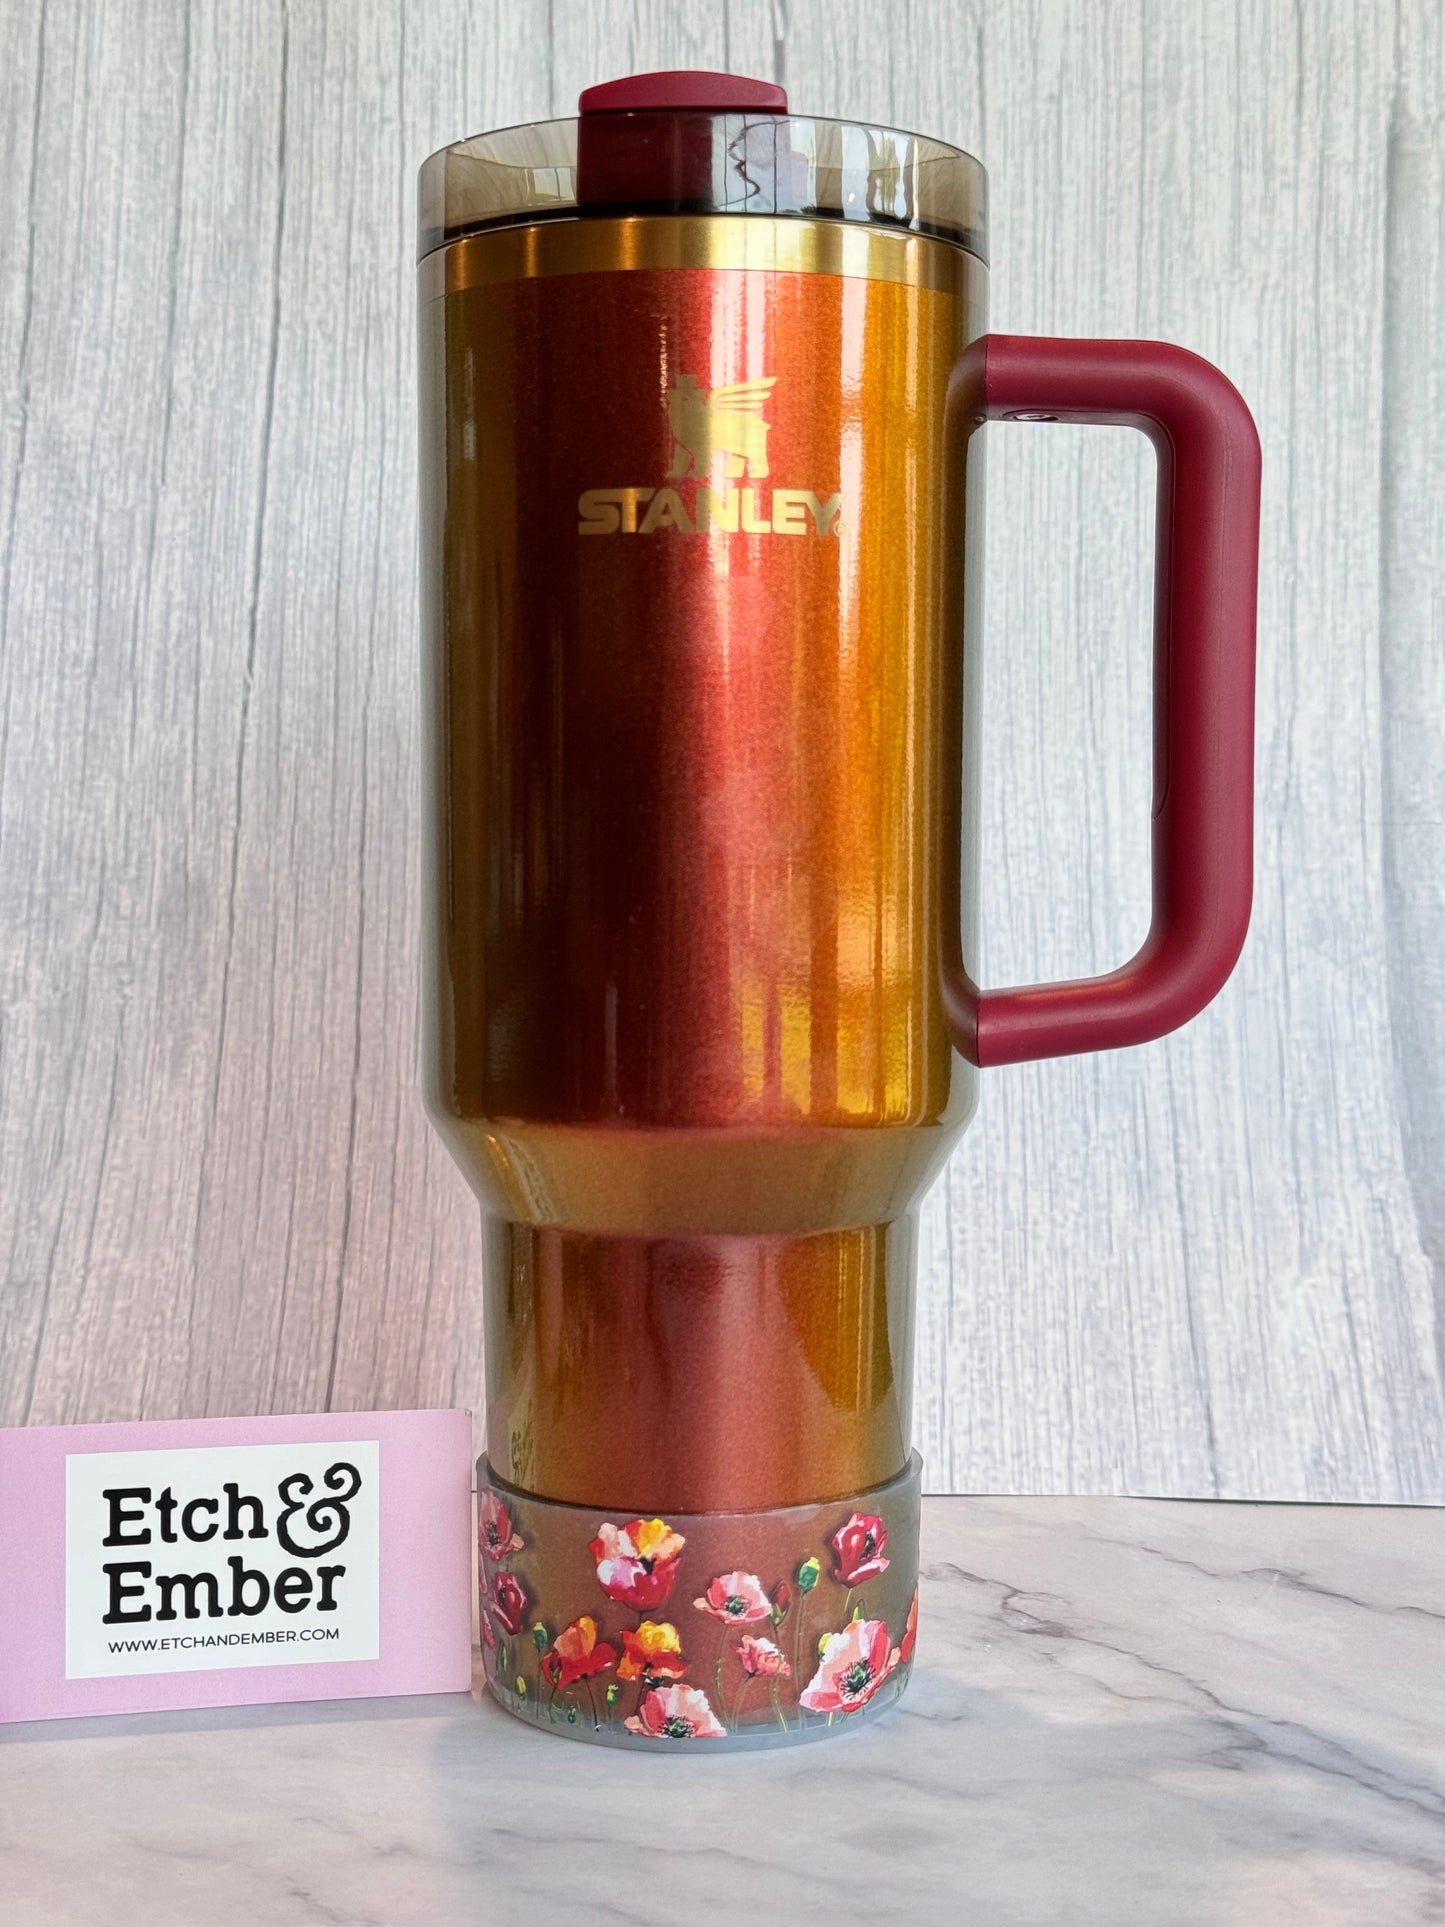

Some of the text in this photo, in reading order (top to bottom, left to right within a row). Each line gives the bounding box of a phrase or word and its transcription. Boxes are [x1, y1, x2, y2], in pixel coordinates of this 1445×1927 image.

[578, 487, 845, 536] STANLEY
[102, 1482, 269, 1547] Etch
[102, 1556, 346, 1624] Ember
[107, 1628, 340, 1653] WWW.ETCHANDEMBER.COM
